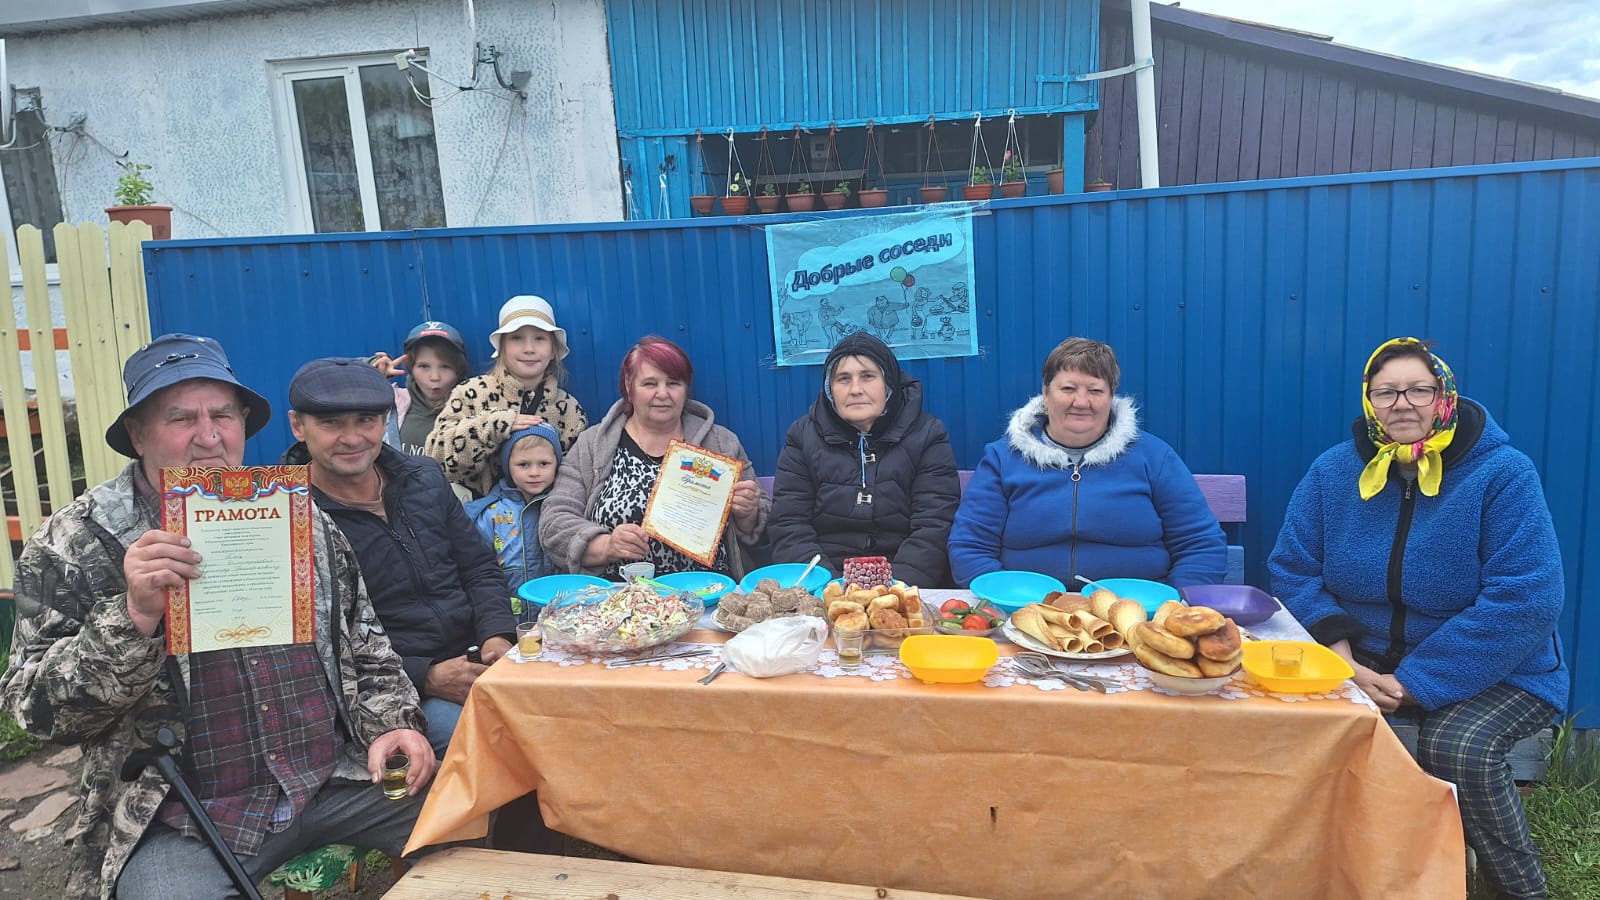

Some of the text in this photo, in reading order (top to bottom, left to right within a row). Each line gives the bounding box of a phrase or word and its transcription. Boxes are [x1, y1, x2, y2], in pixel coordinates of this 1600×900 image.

[792, 232, 953, 292] Добрые соседи
[194, 507, 282, 523] ГРАМОТА
